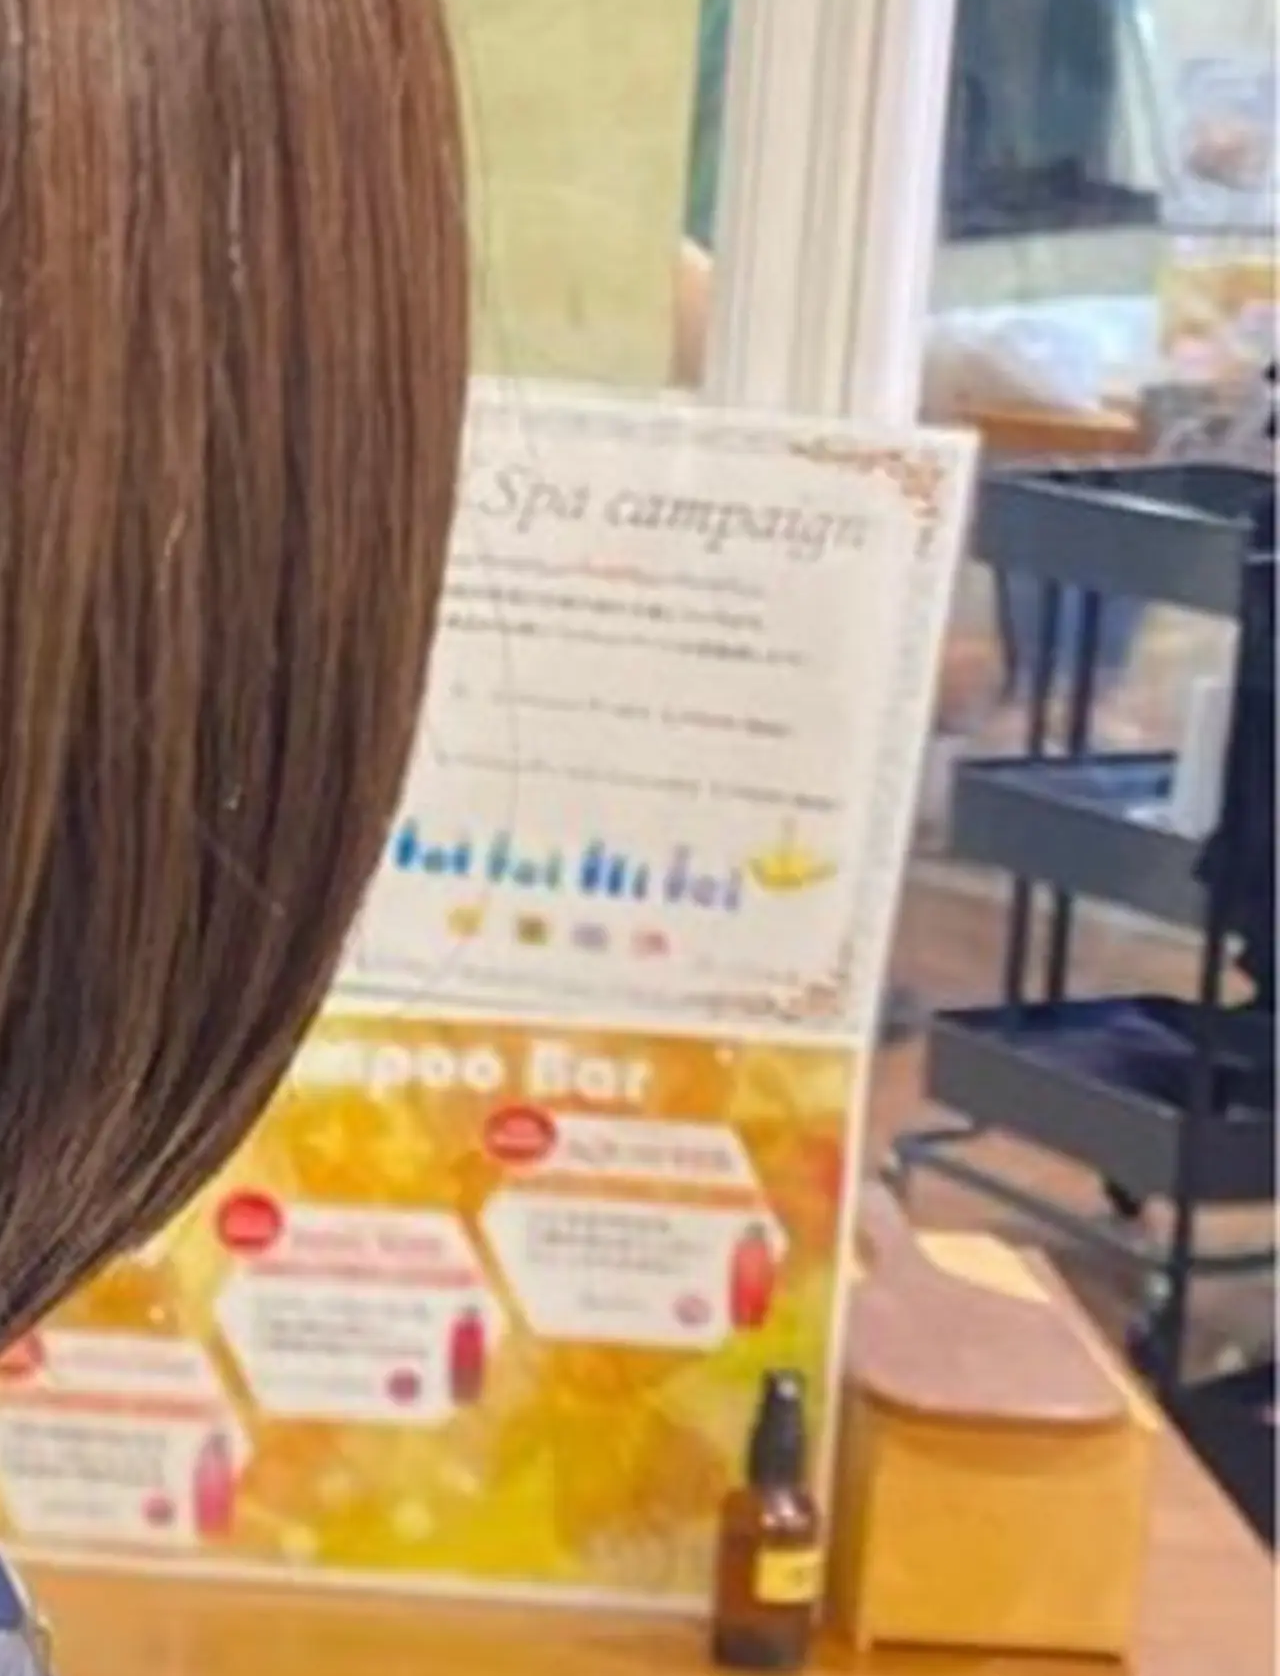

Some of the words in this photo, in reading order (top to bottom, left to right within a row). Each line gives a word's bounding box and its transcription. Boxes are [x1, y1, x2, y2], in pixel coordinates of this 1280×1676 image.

[478, 464, 590, 533] Spa
[604, 489, 868, 562] campaign
[529, 1040, 652, 1101] Bar
